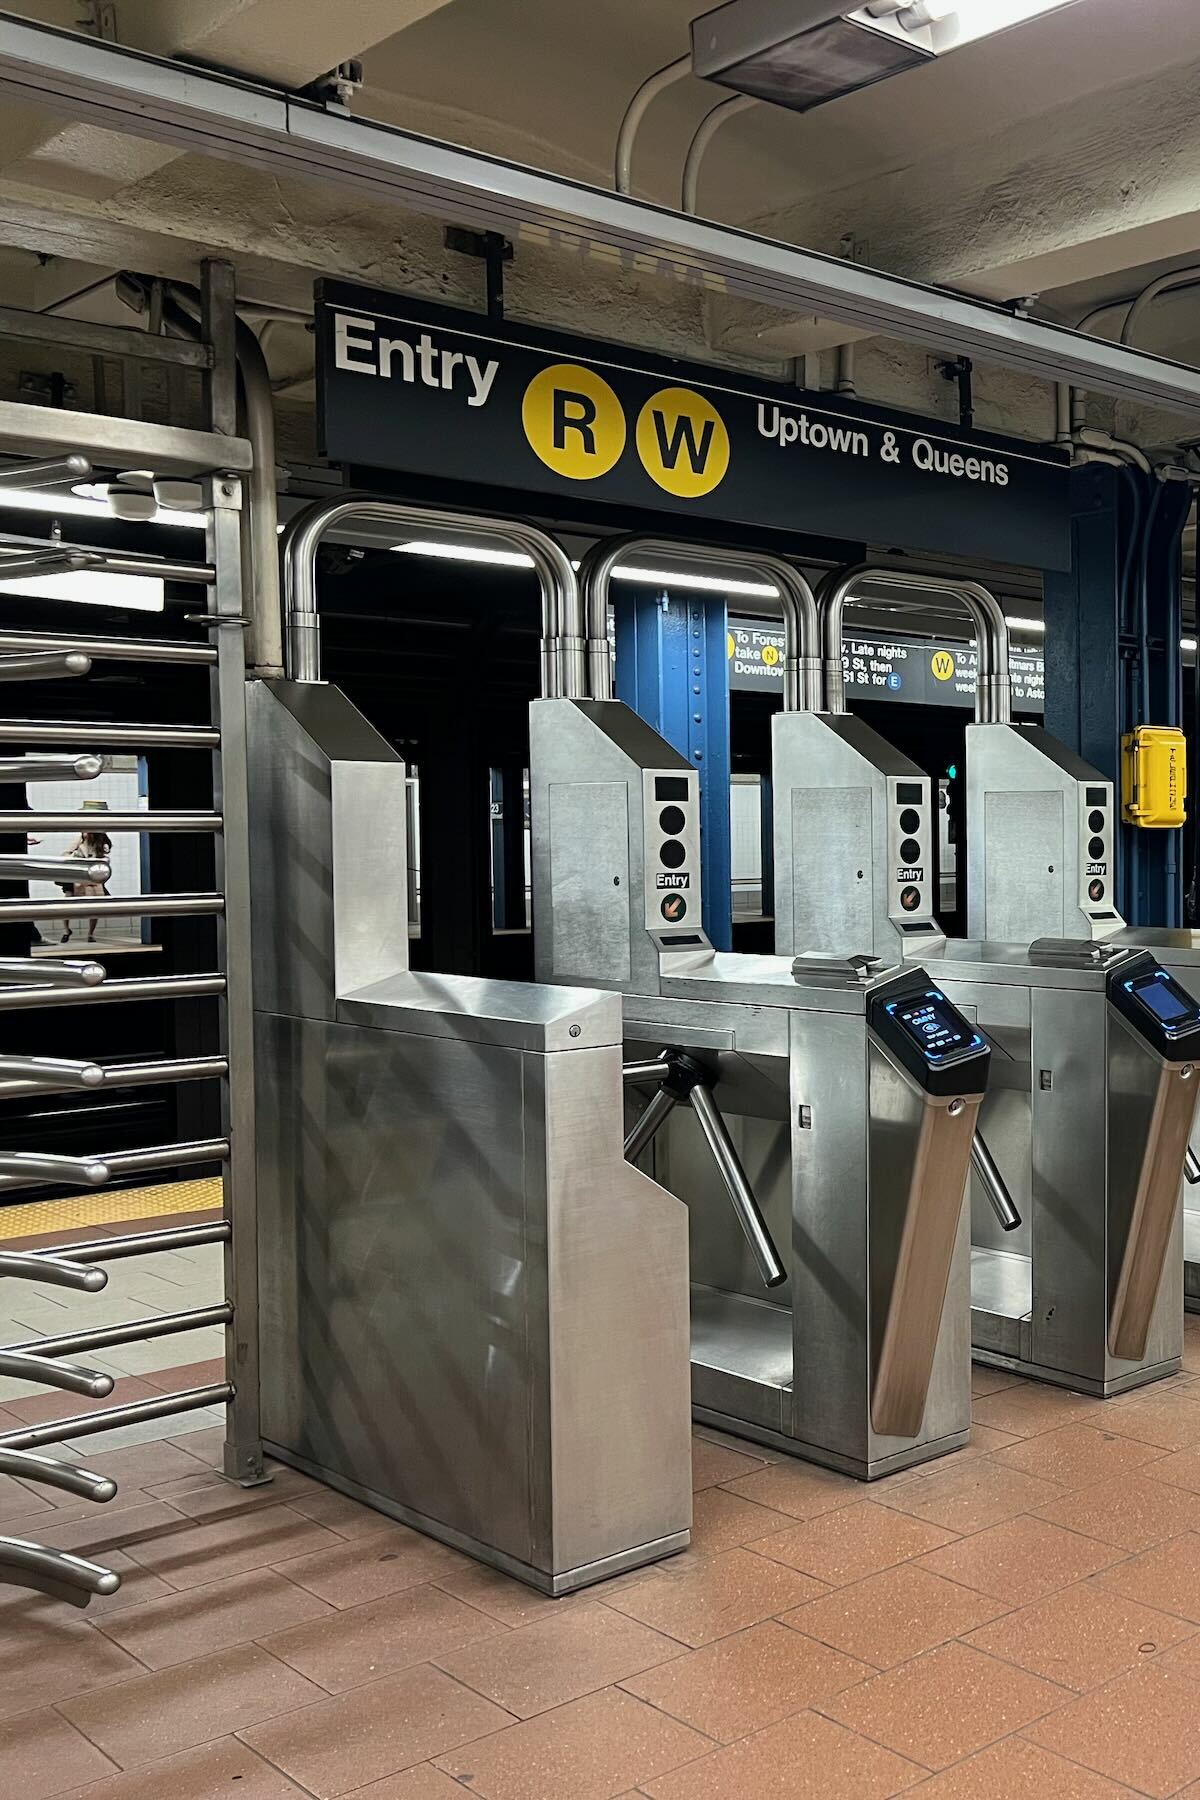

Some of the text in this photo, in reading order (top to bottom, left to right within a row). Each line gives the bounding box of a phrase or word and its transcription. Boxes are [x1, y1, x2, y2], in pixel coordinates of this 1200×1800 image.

[334, 312, 1009, 486] Entry R W Uptown & Queens
[735, 631, 785, 647] To Fores
[735, 649, 761, 660] take
[852, 642, 875, 657] Late
[877, 646, 908, 660] nights
[852, 656, 867, 672] St,
[870, 661, 893, 673] then
[955, 652, 967, 665] To
[857, 674, 869, 684] St
[872, 674, 887, 686] for
[1015, 687, 1025, 697] to
[490, 803, 500, 814] 23
[897, 868, 922, 882] Entry
[1086, 863, 1106, 876] Entry
[656, 873, 688, 889] Entry
